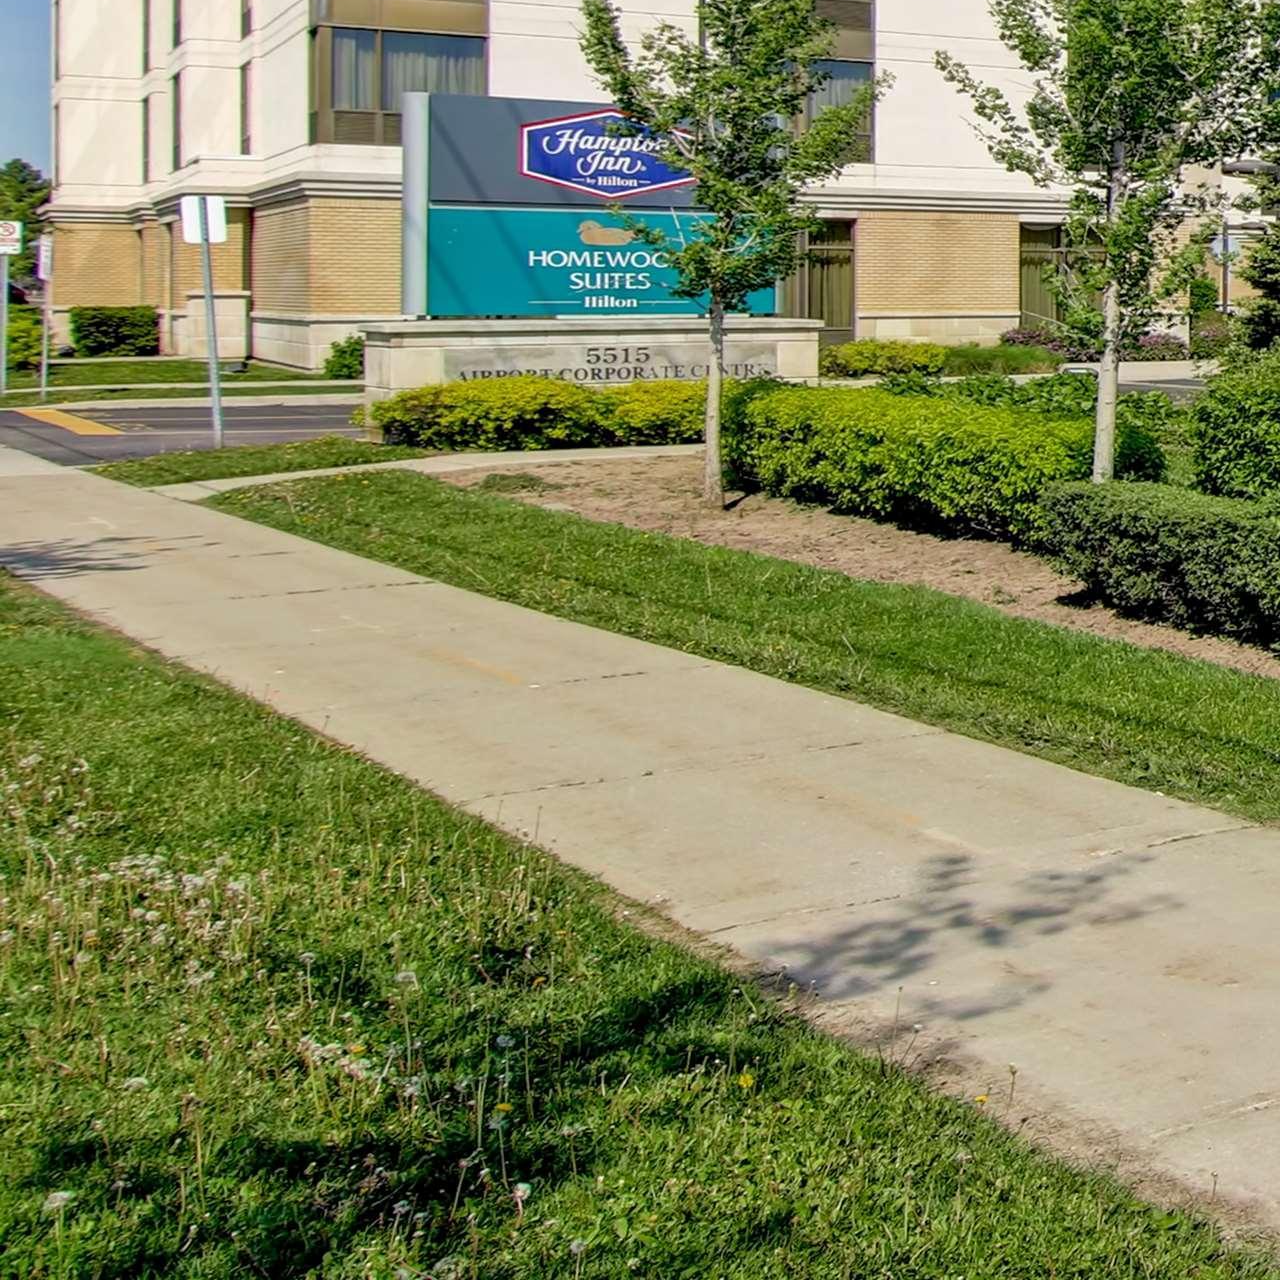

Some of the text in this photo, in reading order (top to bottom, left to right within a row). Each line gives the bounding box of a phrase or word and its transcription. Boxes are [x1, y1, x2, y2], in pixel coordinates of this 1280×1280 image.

[576, 151, 642, 176] Inn
[597, 176, 638, 187] Hilton
[528, 250, 670, 268] HOMEWOO
[569, 273, 652, 290] SUITES
[584, 295, 638, 308] Hilton
[586, 346, 651, 365] 5515
[558, 365, 686, 381] CORPORATE
